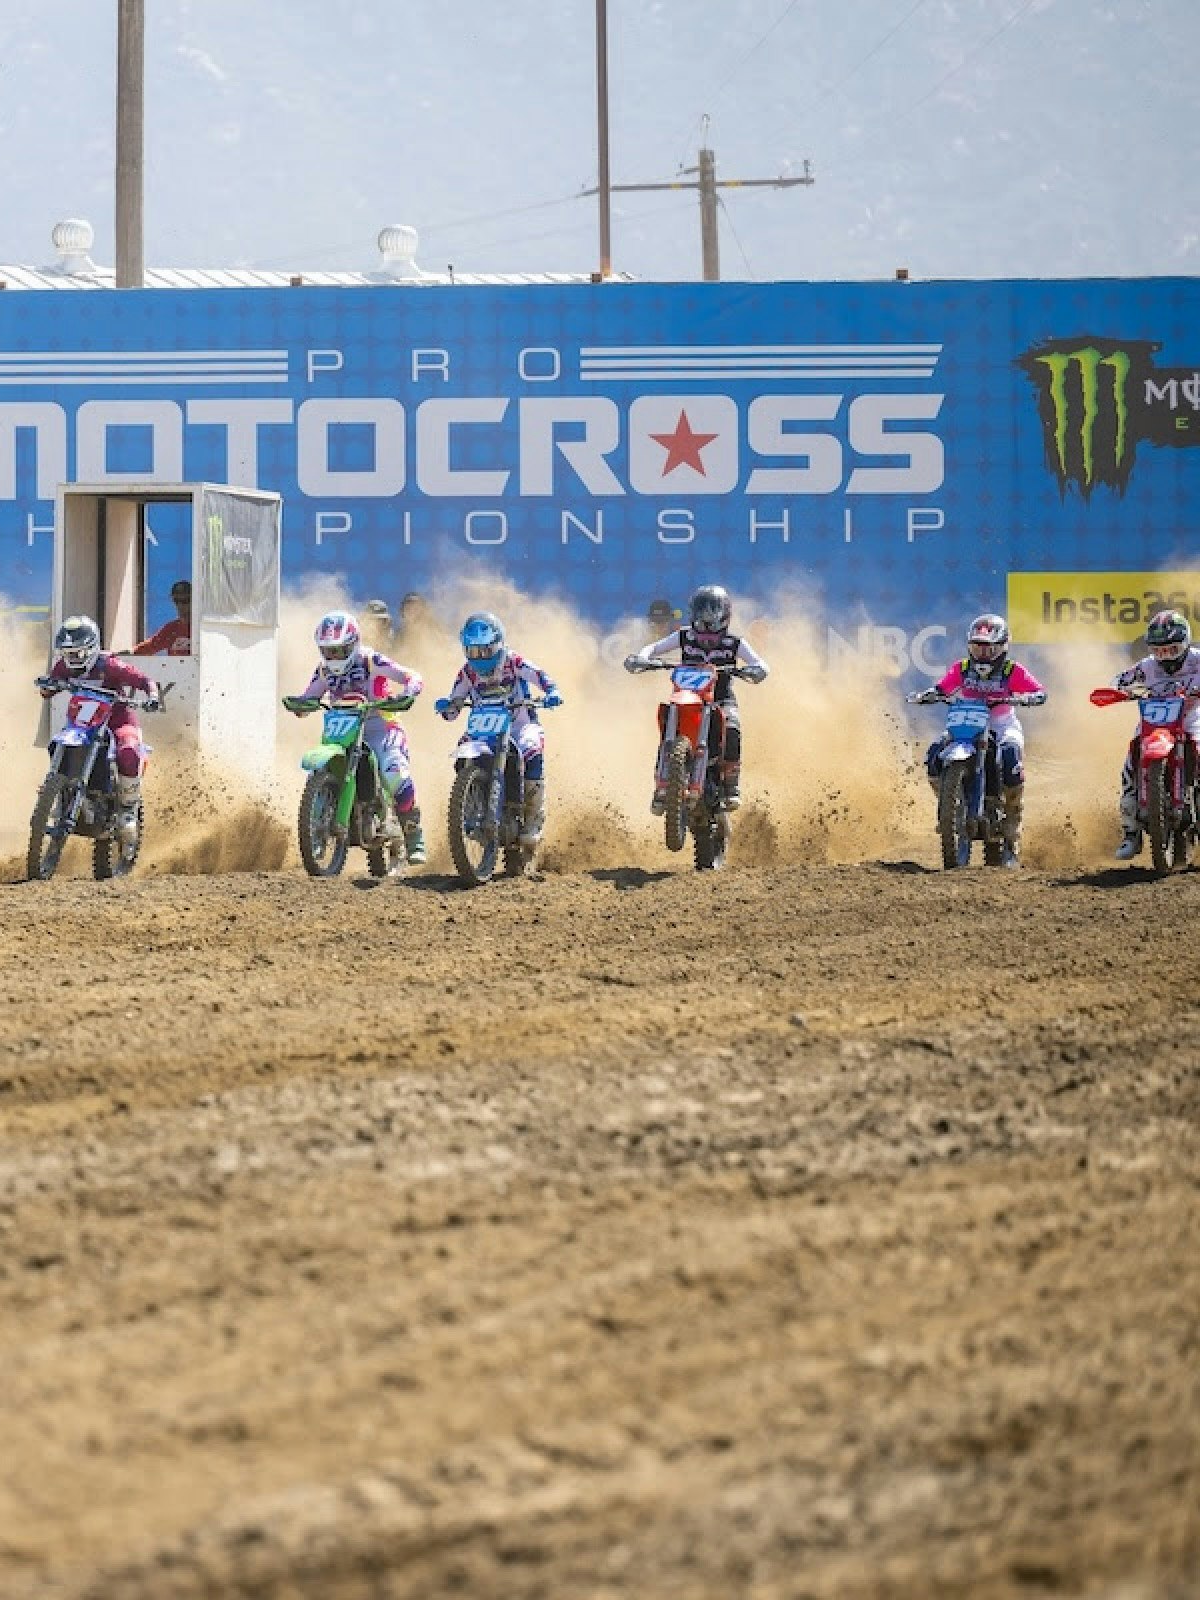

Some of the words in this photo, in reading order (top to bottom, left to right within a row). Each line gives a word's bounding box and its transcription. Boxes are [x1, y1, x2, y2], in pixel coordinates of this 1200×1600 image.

[307, 347, 560, 383] PRO
[827, 625, 946, 677] NBC
[74, 701, 101, 725] 1
